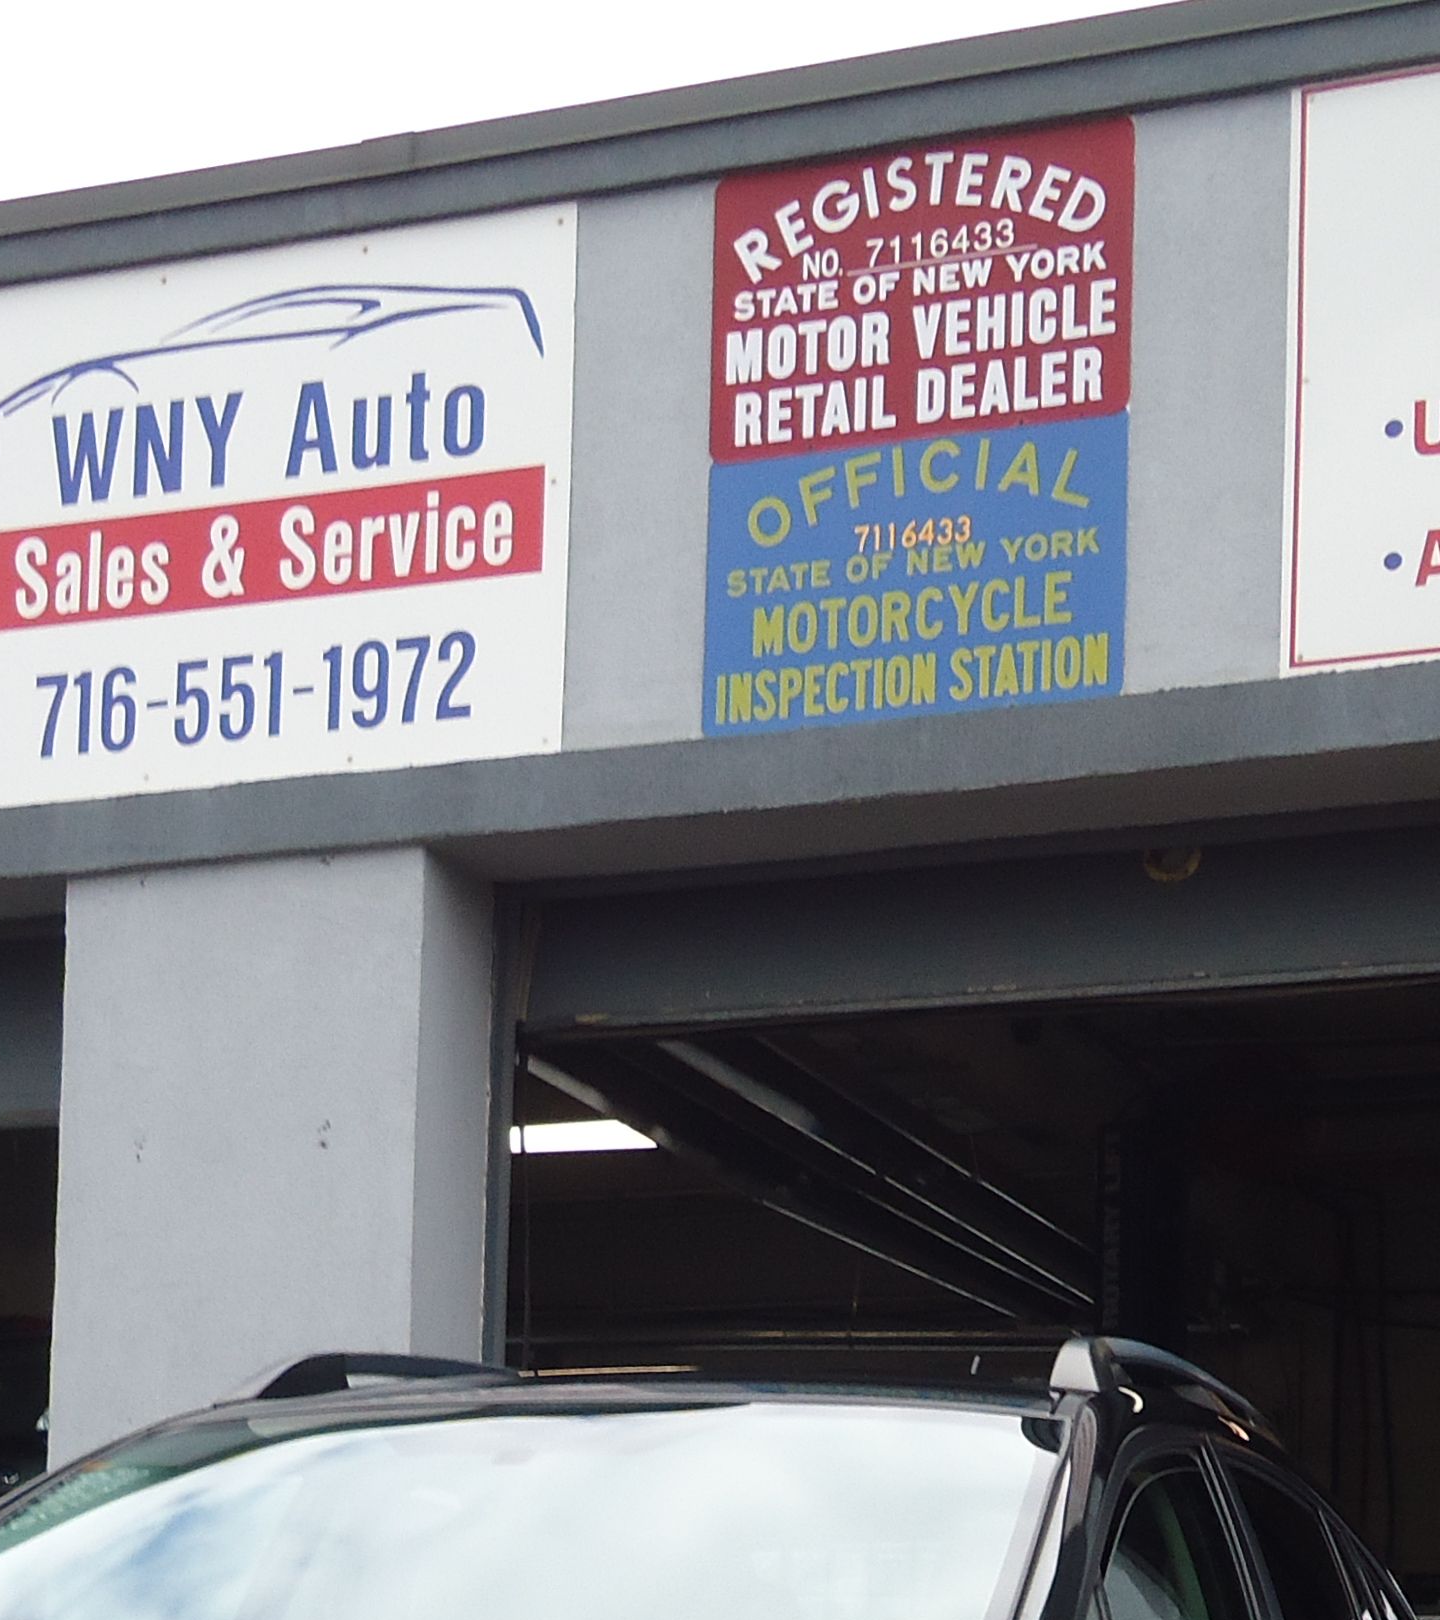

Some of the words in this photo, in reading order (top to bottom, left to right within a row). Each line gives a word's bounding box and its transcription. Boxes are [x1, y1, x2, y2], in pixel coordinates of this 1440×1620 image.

[733, 150, 1108, 285] REGISTERED
[802, 248, 844, 282] NO.
[865, 218, 1016, 268] 7116433
[725, 310, 890, 386] MOTOR
[913, 279, 1117, 360] VEHICLE
[734, 280, 839, 322] STATE
[853, 270, 898, 306] OF
[912, 254, 994, 297] NEW
[1005, 241, 1108, 281] YORK
[52, 390, 244, 507] WNY
[285, 371, 485, 481] Auto
[734, 378, 897, 447] RETAIL
[916, 345, 1103, 424] DEALER
[748, 437, 1091, 548] OFFICIAL
[854, 516, 973, 554] 7116433
[13, 536, 170, 621] Sales
[201, 514, 246, 599] &
[278, 490, 514, 592] Service
[727, 560, 831, 599] STATE
[846, 551, 893, 584] OF
[907, 540, 987, 576] NEW
[999, 526, 1101, 563] YORK
[752, 570, 1073, 659] MOTORCYCLE
[35, 630, 477, 760] 716-551-1972
[714, 653, 937, 725] INSPECTION
[949, 633, 1109, 700] STATION
